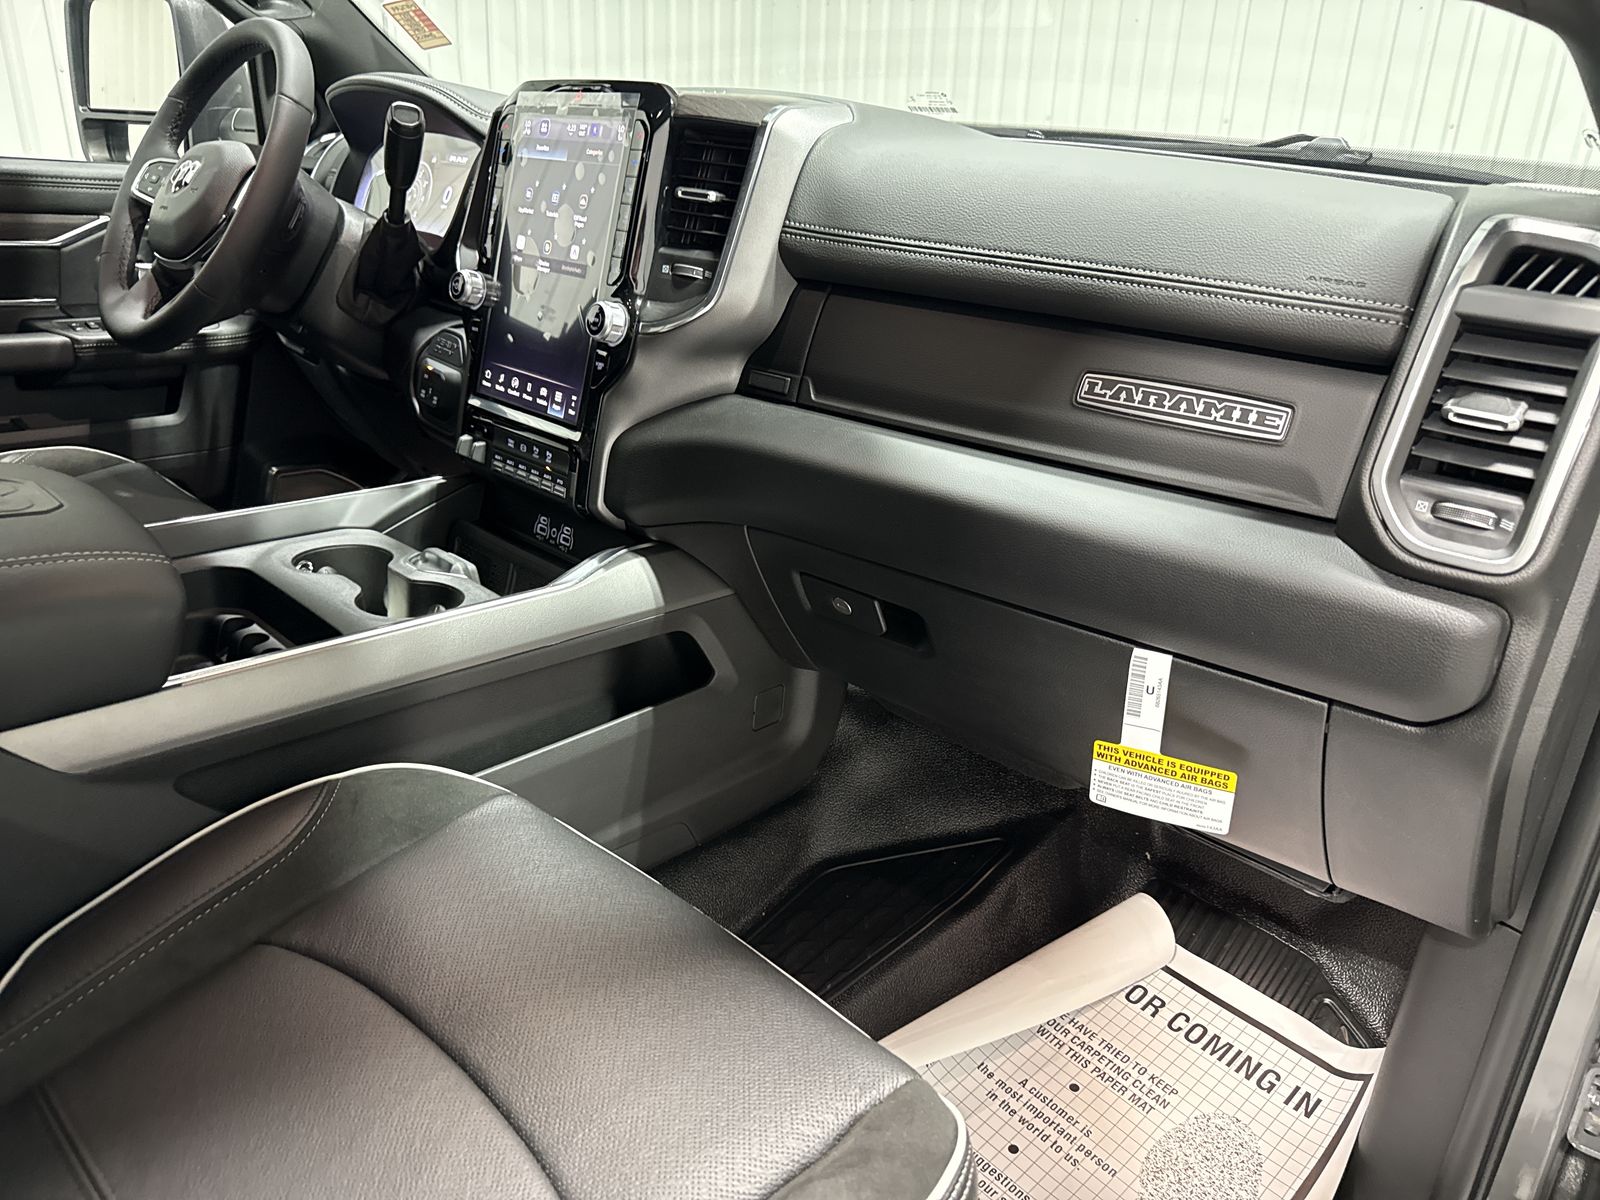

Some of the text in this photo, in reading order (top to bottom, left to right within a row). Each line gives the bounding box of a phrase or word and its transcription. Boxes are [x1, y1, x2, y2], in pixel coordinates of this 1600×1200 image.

[1081, 378, 1288, 433] LARAMIE
[1146, 685, 1155, 696] U
[1096, 752, 1228, 790] WITH ADVANCED AIR BAGS
[1097, 744, 1230, 782] THIS VEHICLE IS EQUIPPED
[1108, 764, 1125, 773] EVEN
[1126, 769, 1142, 778] WITH
[1143, 773, 1179, 787] ADVANCED
[1193, 786, 1212, 795] BAGS
[1036, 1024, 1156, 1116] WITH THIS PAPER MAT
[1068, 1018, 1098, 1042] HAVE
[1098, 1038, 1131, 1064] TRIED
[1132, 1061, 1148, 1076] TO
[1148, 1073, 1179, 1096] KEEP
[1070, 1035, 1132, 1082] CARPETING
[1132, 1079, 1171, 1110] CLEAN
[1167, 1012, 1281, 1094] COMING
[1282, 1085, 1322, 1119] IN
[977, 1062, 1118, 1178] the most important person
[986, 1088, 1080, 1171] in the world to us.
[1018, 1078, 1093, 1138] A customer is
